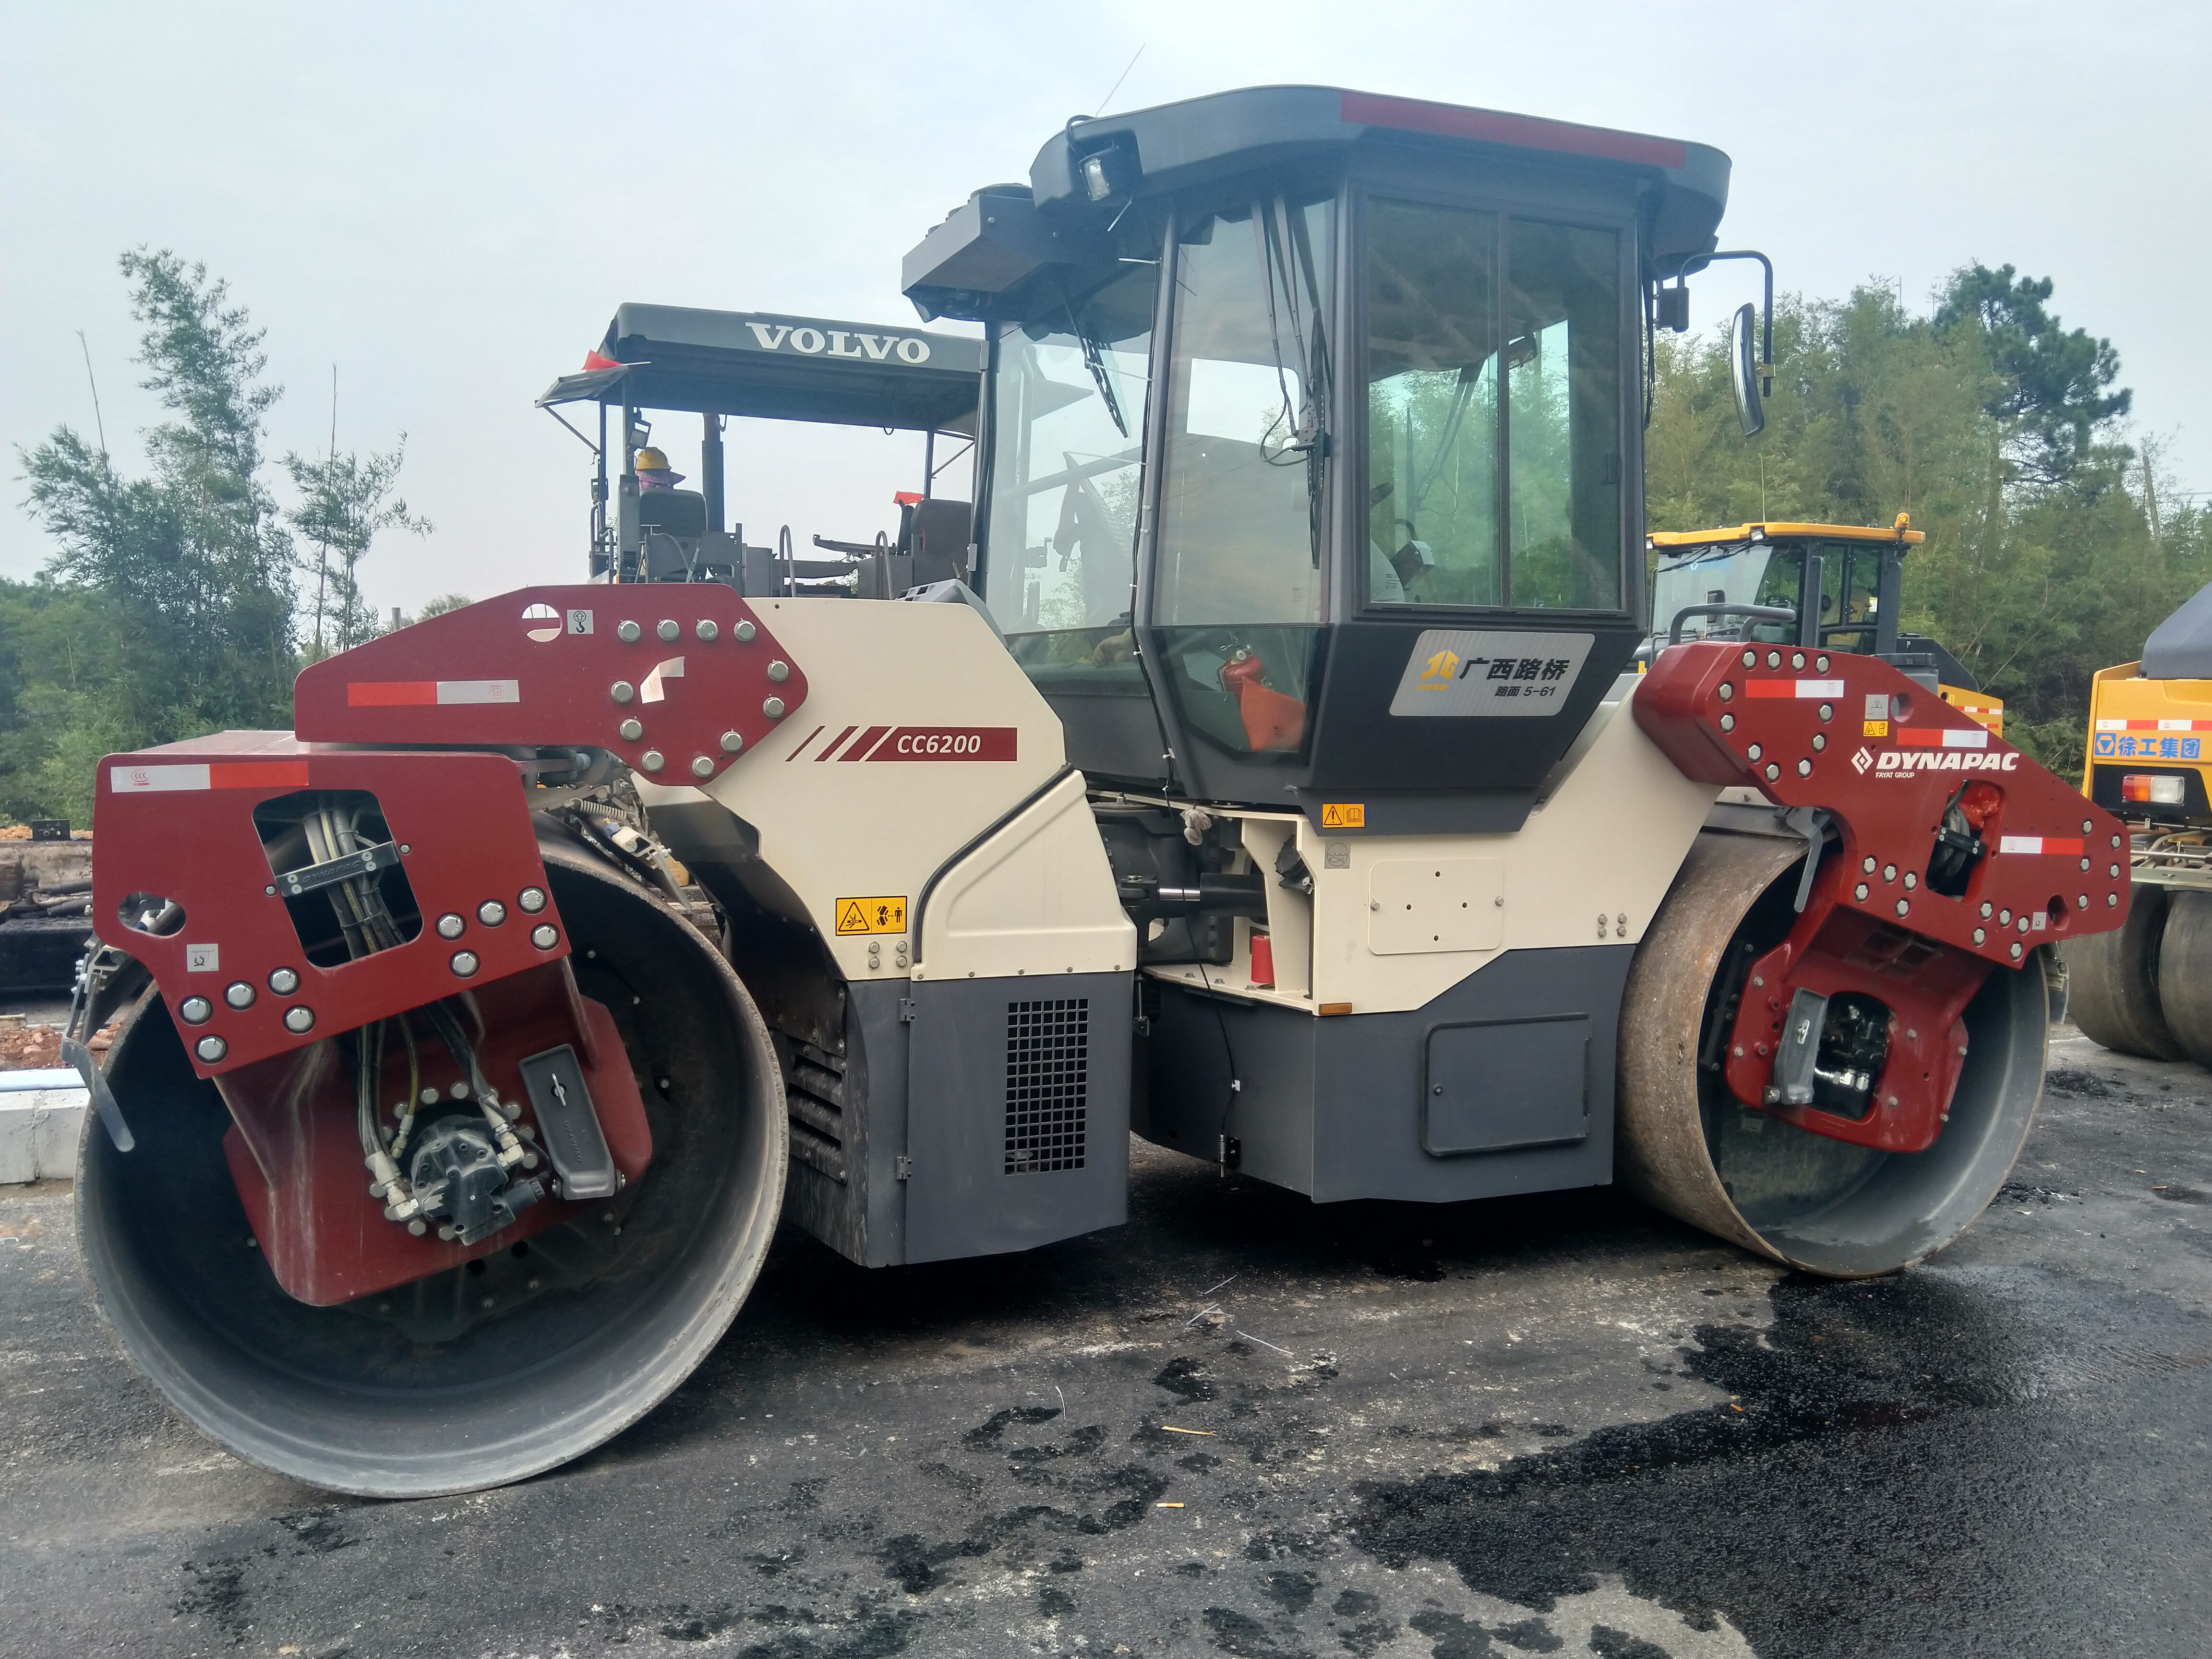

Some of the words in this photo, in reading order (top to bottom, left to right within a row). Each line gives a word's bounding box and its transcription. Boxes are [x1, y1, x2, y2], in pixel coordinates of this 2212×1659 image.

[745, 322, 930, 363] VOLVO
[1458, 657, 1570, 681] 广西路桥
[1494, 686, 1522, 697] 路面
[1523, 686, 1556, 697] 5-61
[897, 735, 981, 754] CC6200
[2117, 736, 2200, 759] 徐工集团
[1875, 752, 2020, 770] DYNAPAC
